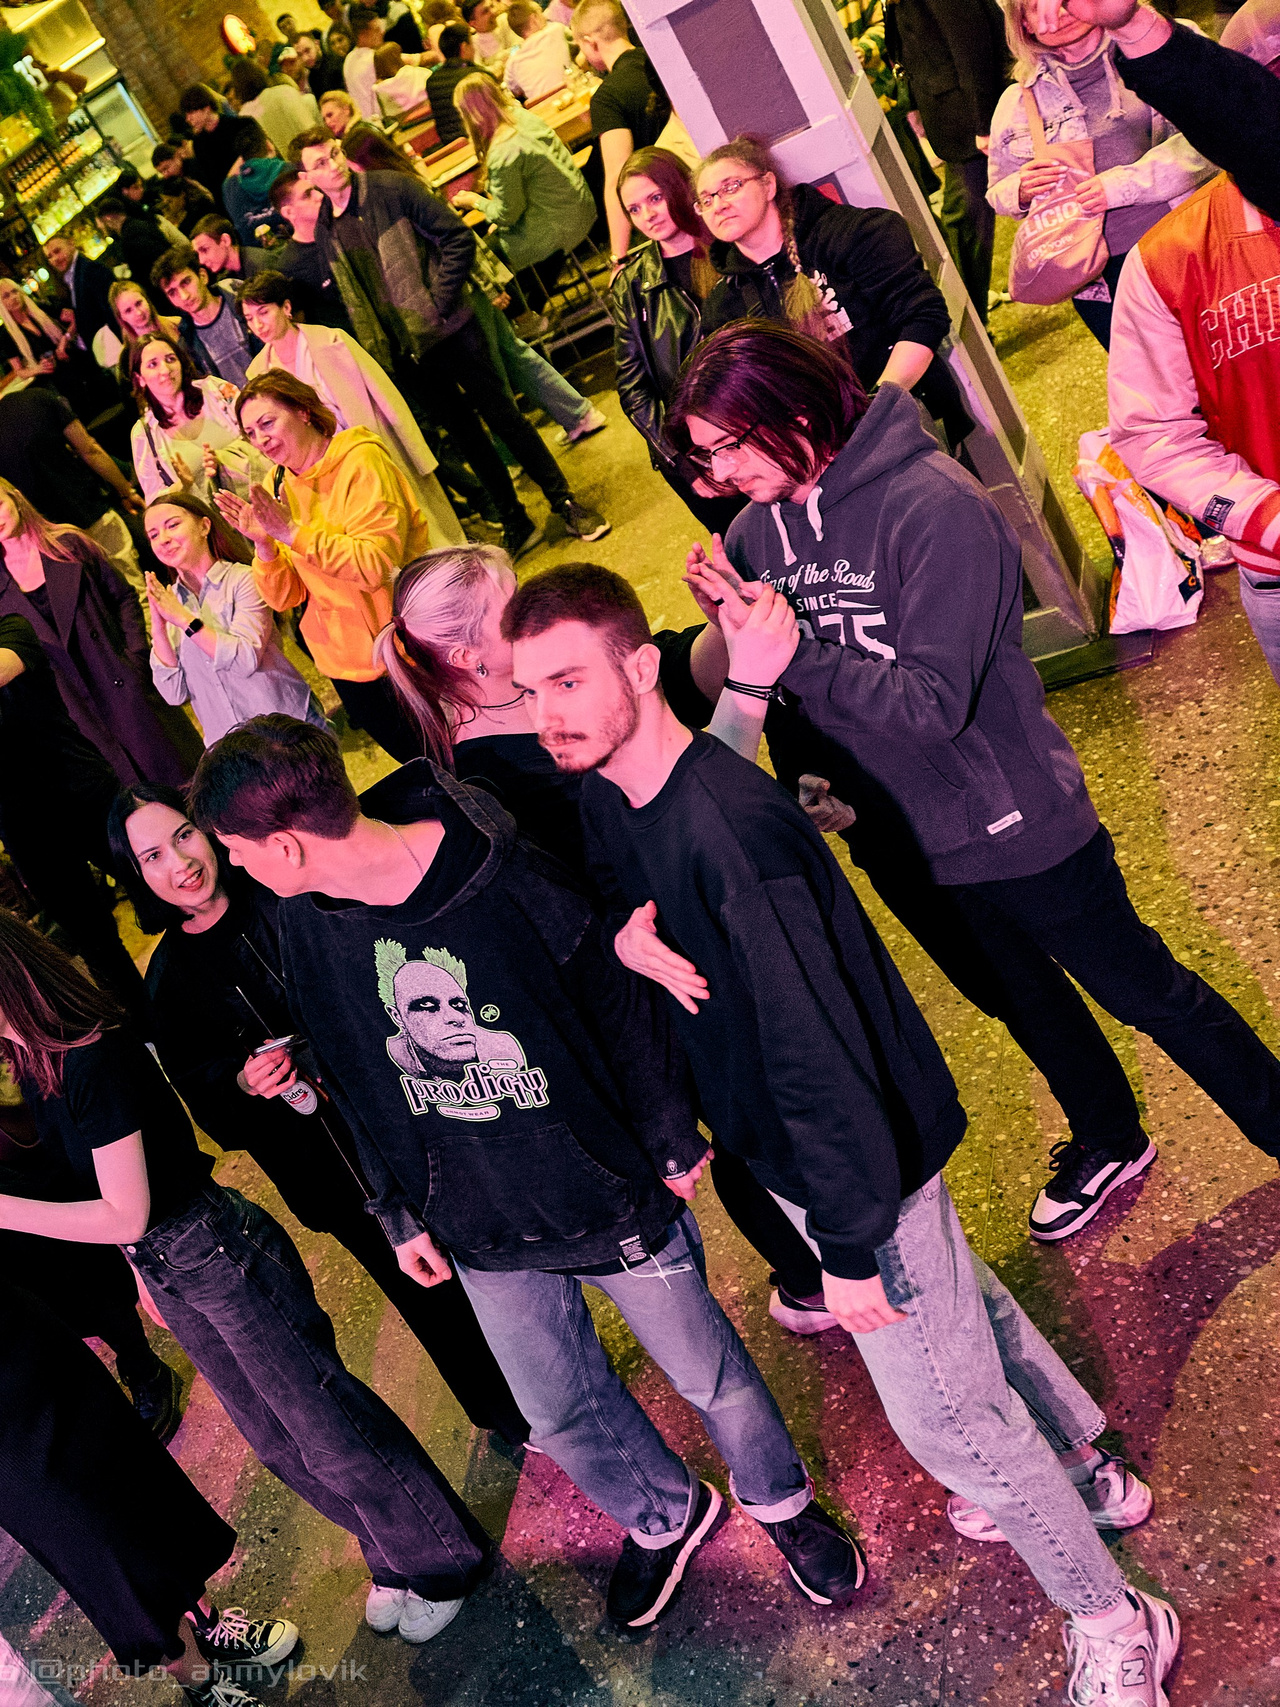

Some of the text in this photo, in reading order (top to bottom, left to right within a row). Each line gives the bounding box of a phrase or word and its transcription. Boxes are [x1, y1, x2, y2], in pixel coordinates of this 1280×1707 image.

[788, 565, 805, 595] of
[804, 563, 829, 585] the
[831, 559, 876, 593] Road
[796, 593, 838, 612] SINCE
[797, 611, 897, 660] 75
[1121, 1657, 1147, 1687] N
